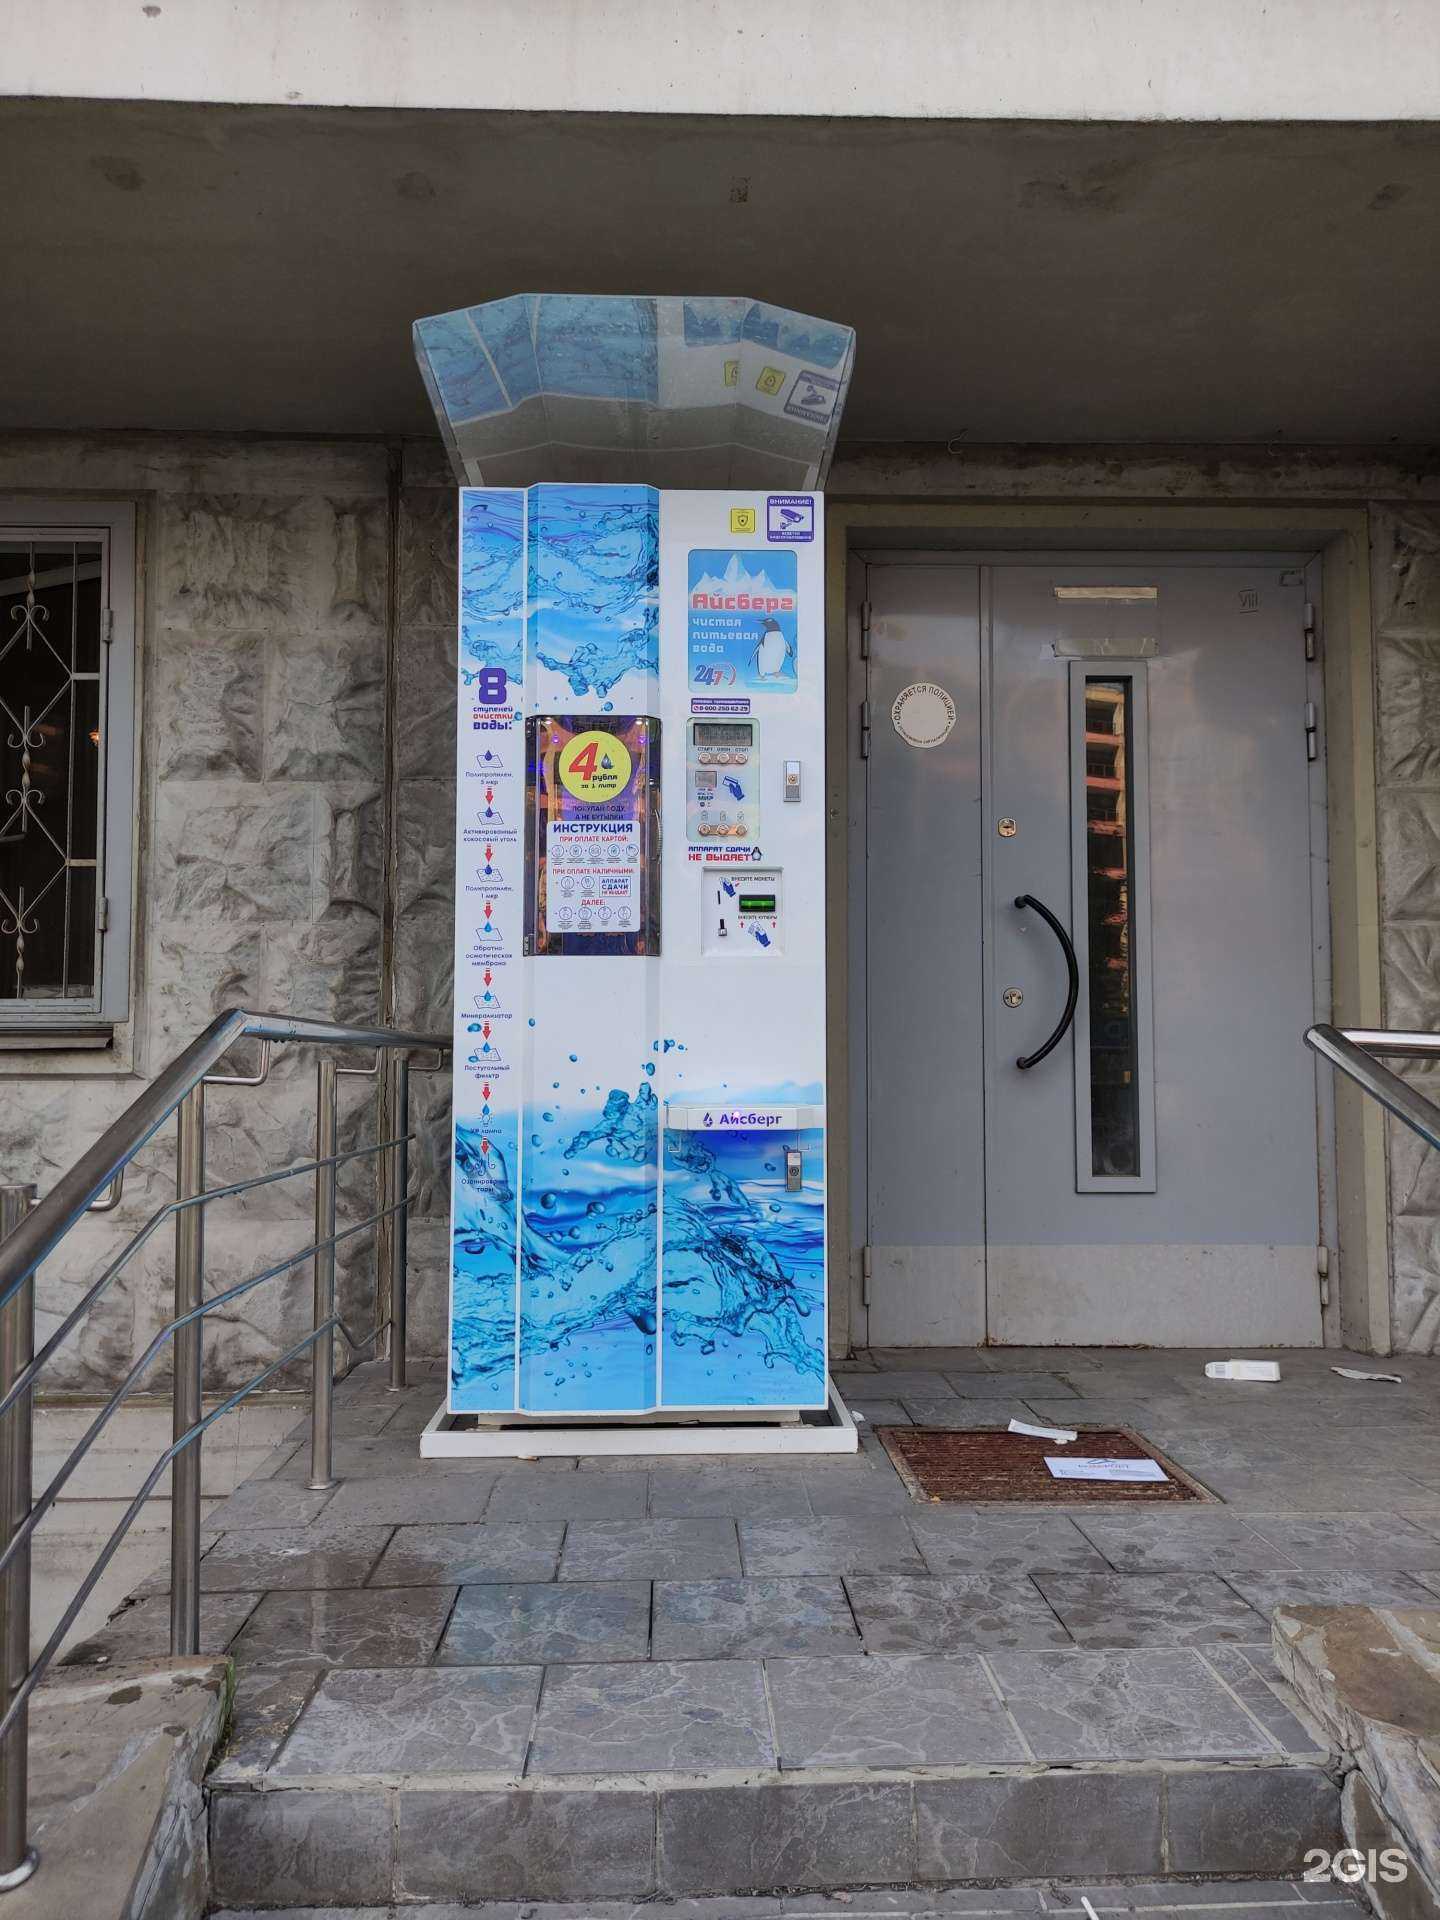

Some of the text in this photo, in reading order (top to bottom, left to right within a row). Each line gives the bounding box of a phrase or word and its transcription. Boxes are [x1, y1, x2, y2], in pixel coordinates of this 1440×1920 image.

[692, 593, 793, 613] Айсберг
[692, 618, 742, 626] чистая
[692, 632, 759, 640] питьевая
[692, 643, 725, 653] вода
[479, 667, 507, 705] 8
[894, 685, 927, 721] ОХРАНЯЕТСЯ
[473, 720, 512, 730] воды:
[568, 743, 599, 781] 4
[553, 823, 633, 834] ИНСТРУКЦИЯ
[688, 853, 751, 861] НЕ ВЫДАЕТ
[566, 867, 591, 875] ОПЛАТЕ
[719, 1112, 783, 1127] Айсберг
